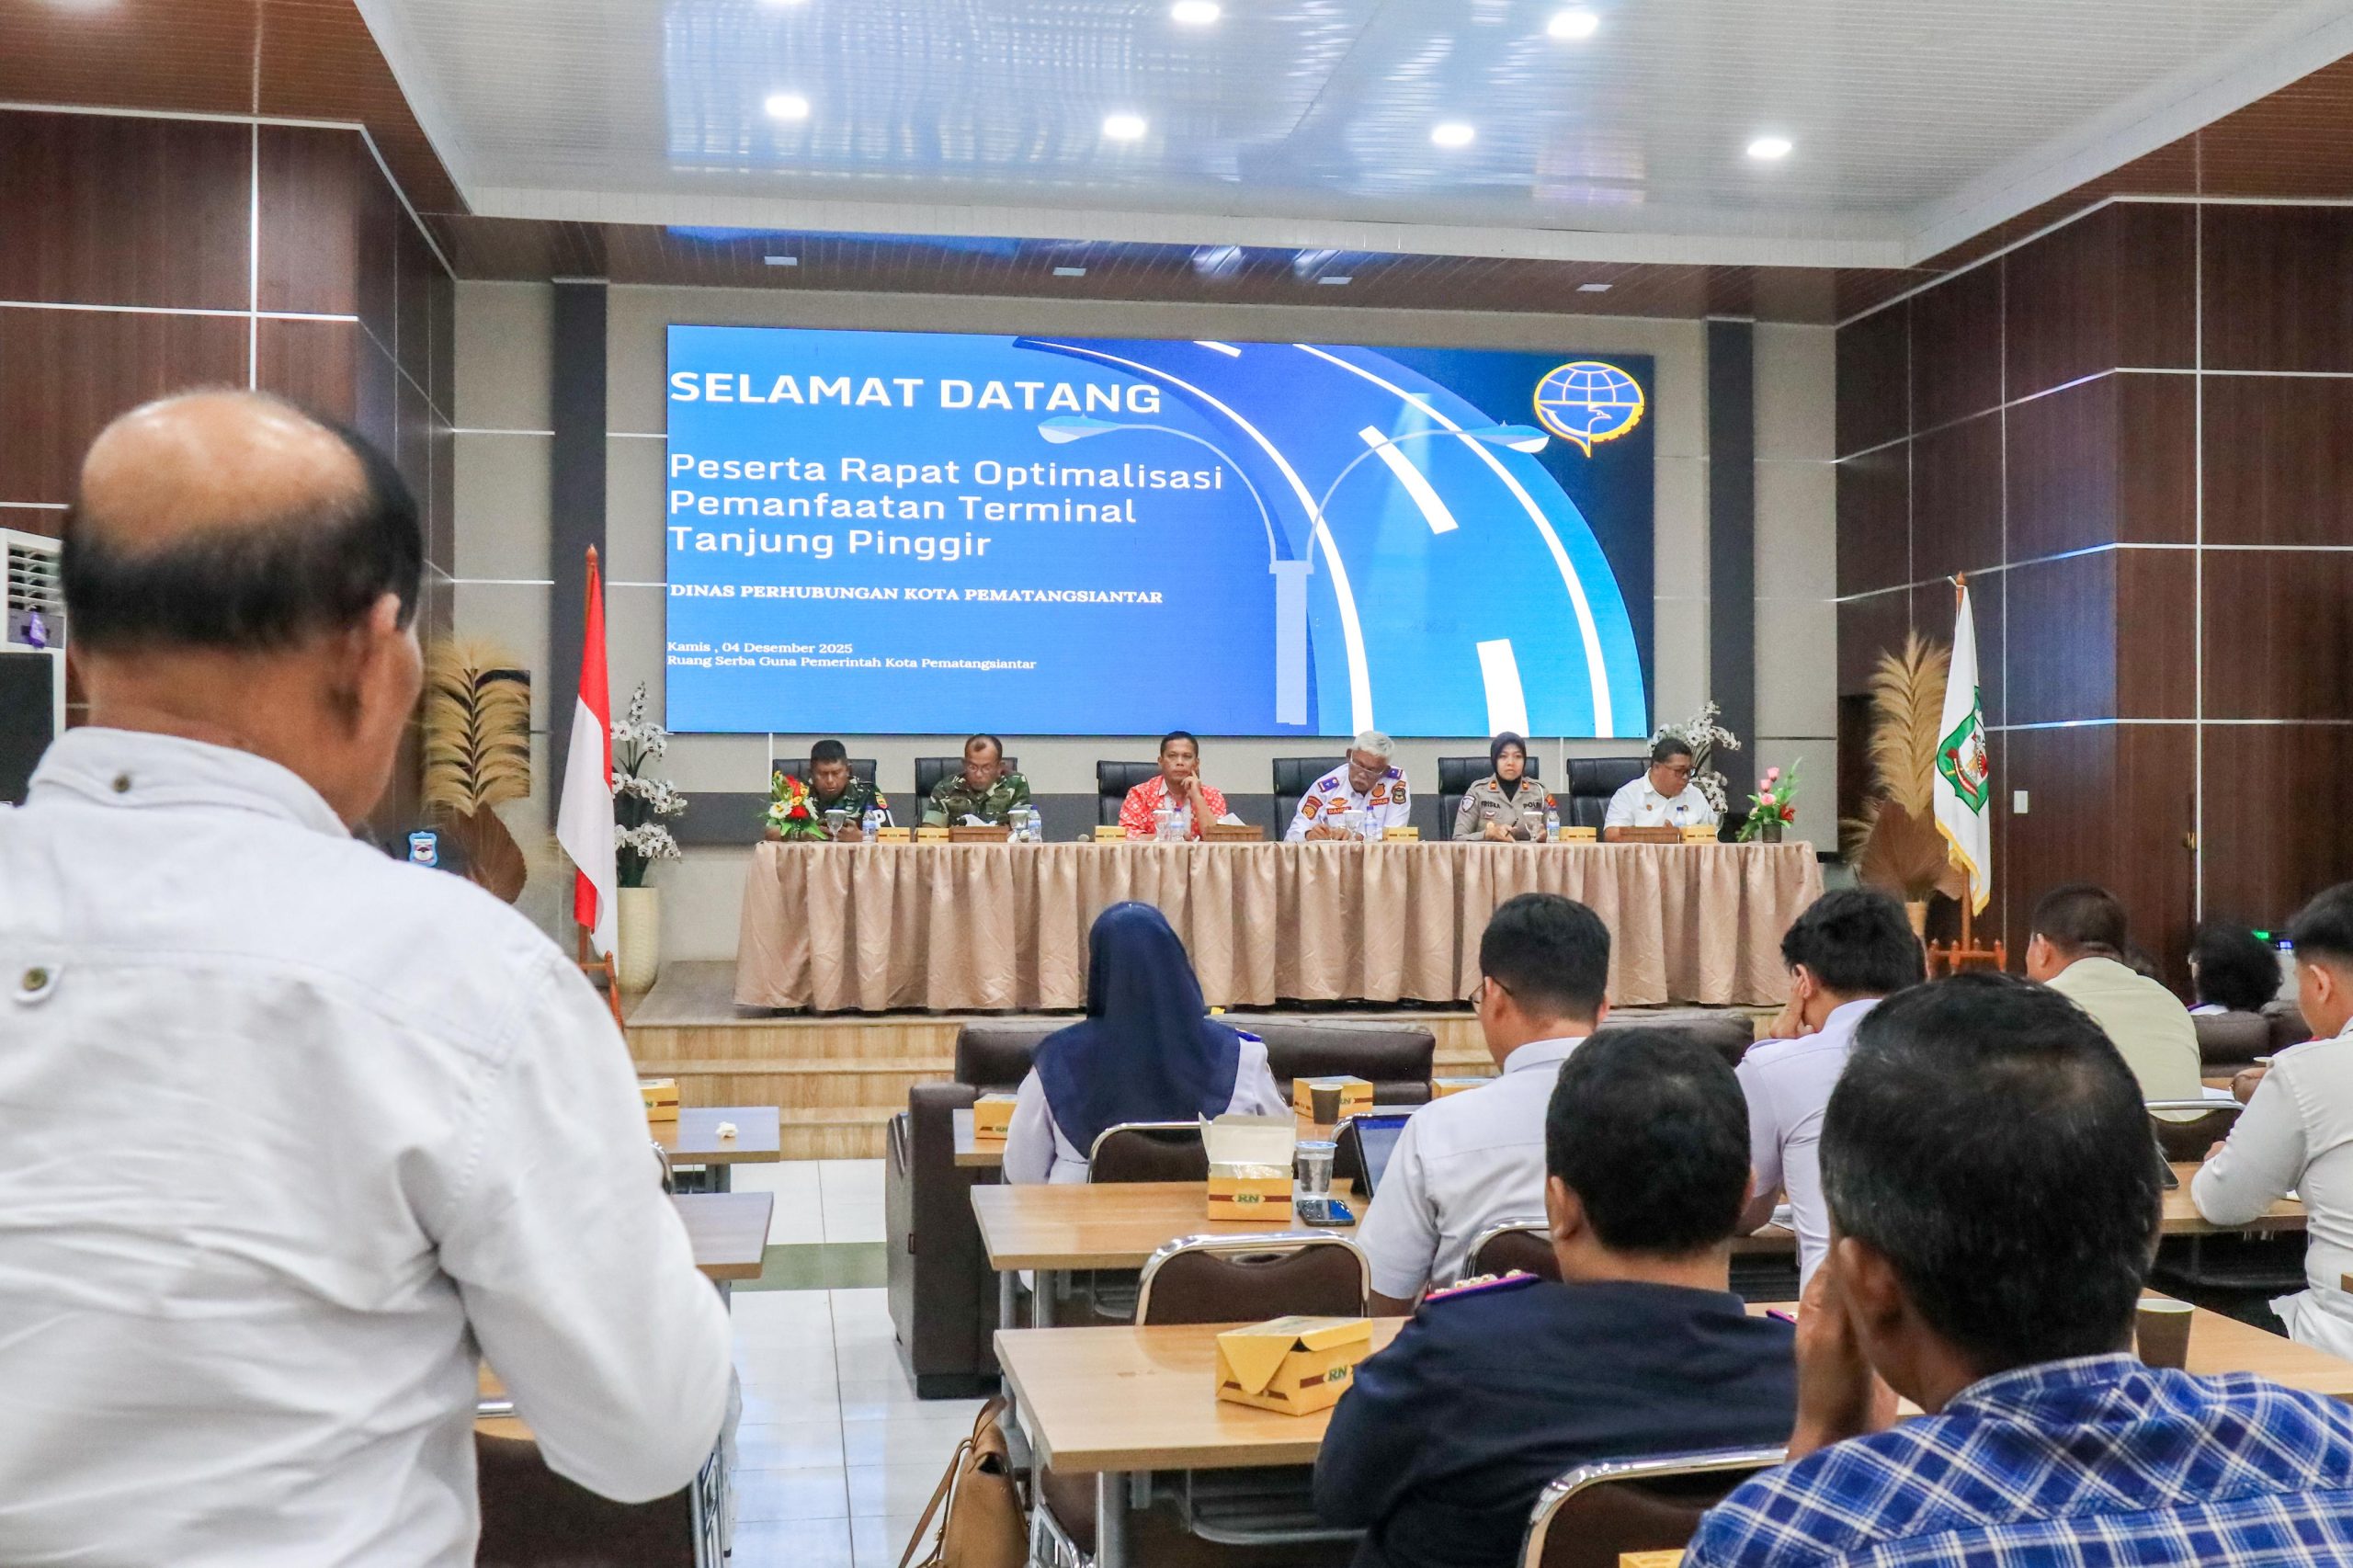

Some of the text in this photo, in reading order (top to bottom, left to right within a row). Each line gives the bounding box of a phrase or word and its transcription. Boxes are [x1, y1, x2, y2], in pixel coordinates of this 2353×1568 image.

[670, 371, 1162, 414] SELAMAT DATANG
[671, 453, 1224, 492] Peserta Rapat Optimalisasi
[670, 490, 1137, 524] Pemanfaatan Terminal
[669, 526, 992, 562] Tanjung Pinggir
[670, 584, 1163, 604] DINAS PERHUBUNGAN KOTA PEMATANGSIANTAR
[666, 642, 711, 653] Kamis
[722, 642, 740, 653] 04
[744, 642, 816, 653] Desember
[818, 643, 854, 654] 2025
[666, 654, 1037, 671] Ruang Serba Guna Pemerintah Kota Pematangsiantar
[1236, 1193, 1260, 1203] RN
[1327, 1366, 1348, 1382] RN
